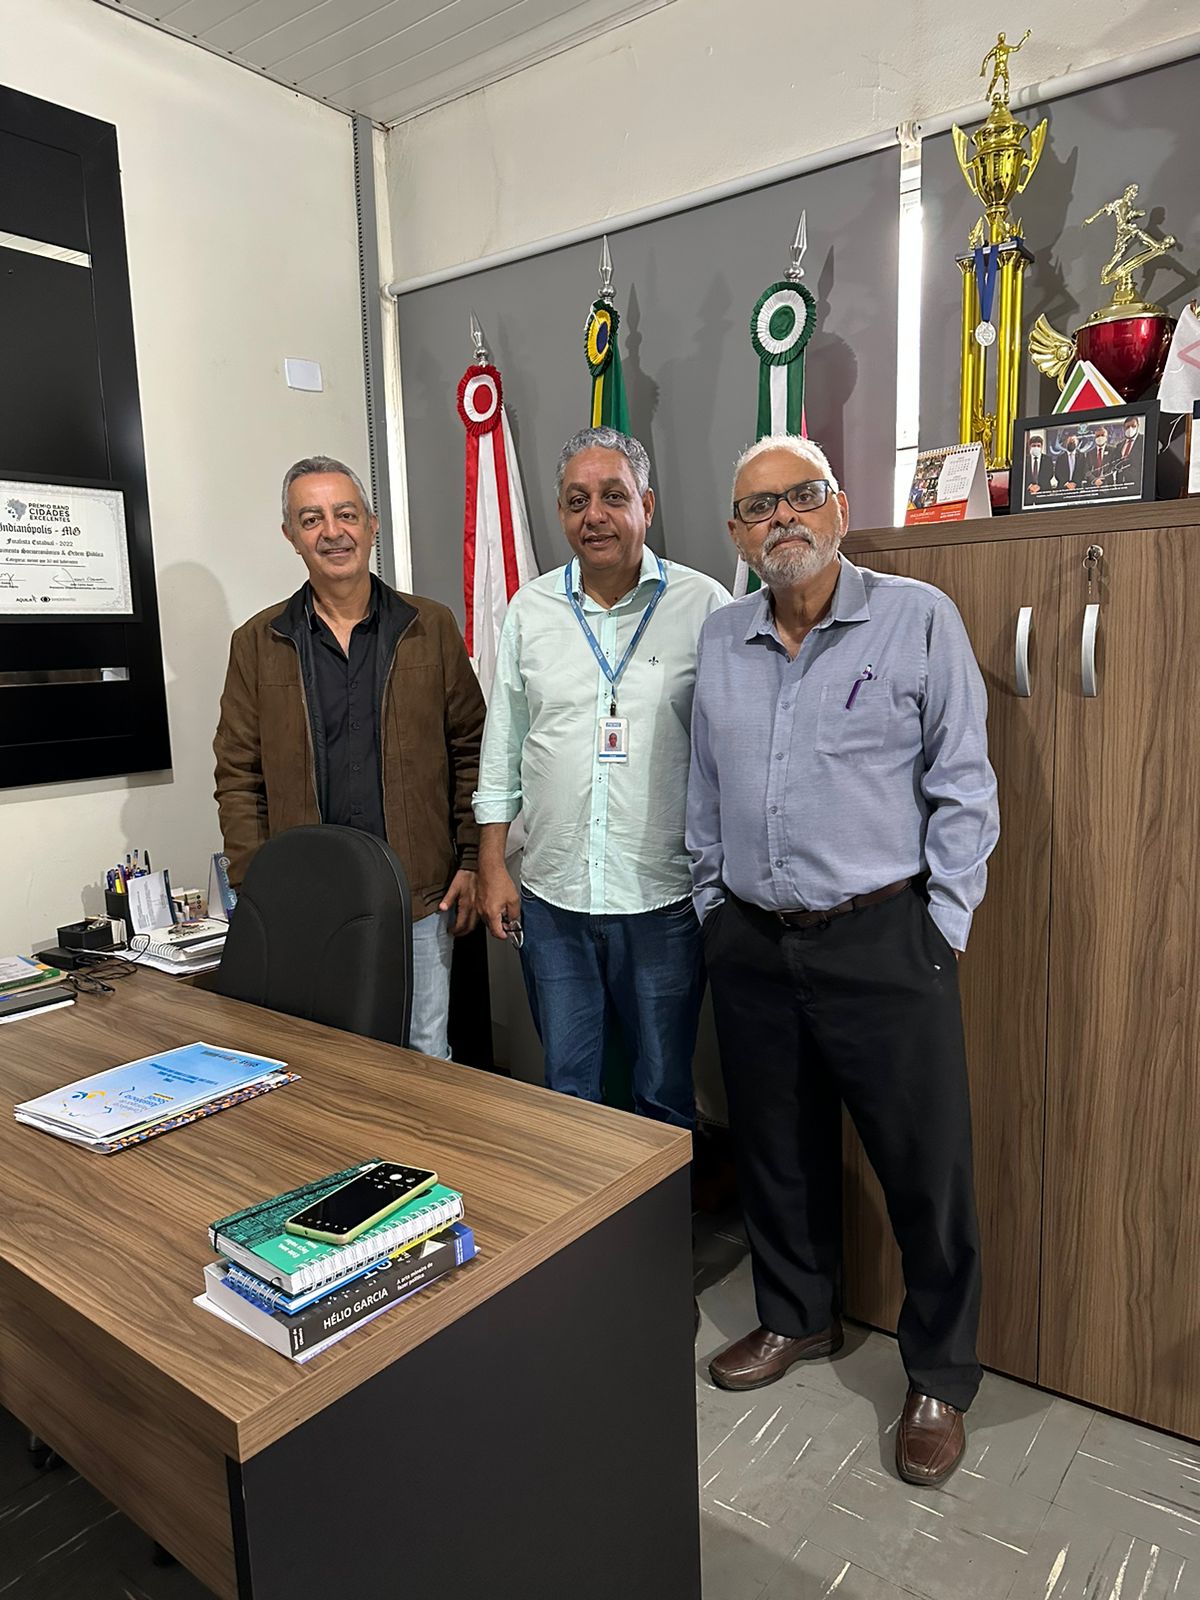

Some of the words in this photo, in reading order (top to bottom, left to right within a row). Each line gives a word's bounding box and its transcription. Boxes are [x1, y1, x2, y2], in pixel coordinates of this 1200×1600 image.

[29, 508, 70, 518] CIDADES
[29, 515, 71, 523] EXCELENTES
[322, 1306, 352, 1330] HÉLIO
[352, 1287, 389, 1314] GARCIA
